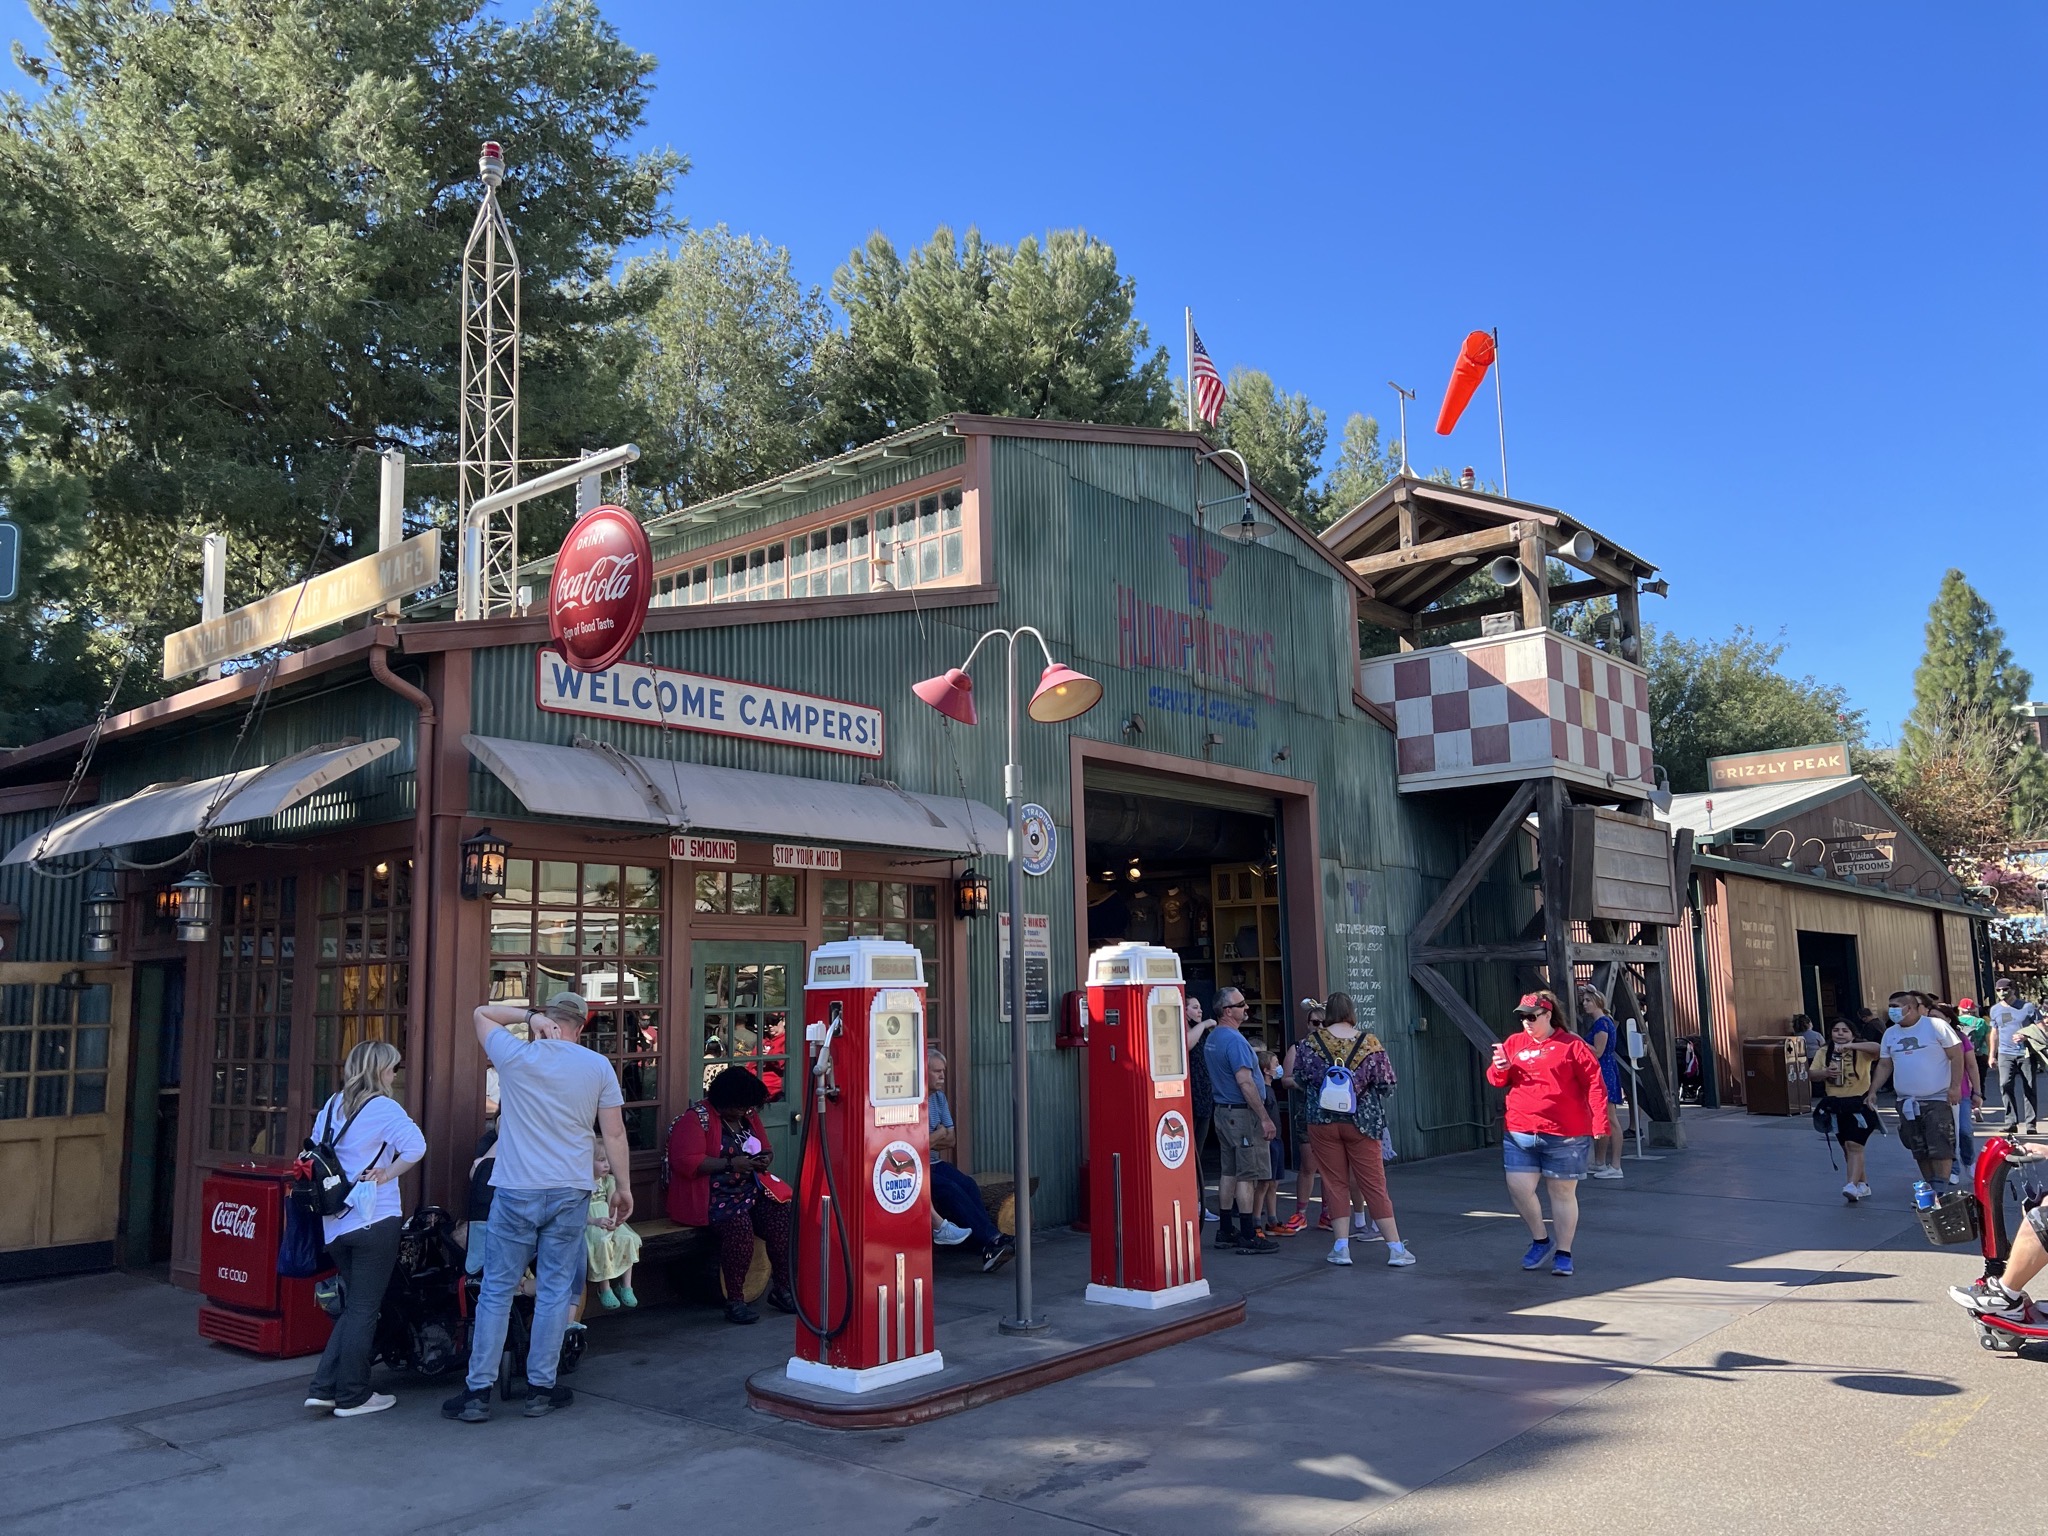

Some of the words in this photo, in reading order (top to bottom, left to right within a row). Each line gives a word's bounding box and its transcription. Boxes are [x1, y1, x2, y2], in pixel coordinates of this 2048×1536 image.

[577, 531, 606, 551] DRINK
[555, 553, 639, 615] Coca-Cola
[195, 625, 226, 658] COLD
[233, 606, 280, 645] DRINKS
[297, 589, 321, 622] AIR
[327, 575, 360, 611] MAIL
[379, 550, 424, 588] MAPS
[563, 627, 574, 641] Sign
[574, 625, 580, 636] of
[580, 618, 596, 635] Good
[595, 617, 614, 631] Taste
[1117, 583, 1276, 705] HUMPHREY'S
[551, 663, 725, 721] WELCOME
[738, 694, 878, 747] CAMPERS!
[1714, 761, 1787, 780] GRIZZLY
[1793, 755, 1841, 771] PEAK
[1027, 808, 1052, 831] TRADING
[670, 838, 685, 856] NO
[690, 839, 735, 860] SMOKING
[775, 846, 793, 864] STOP
[796, 849, 813, 865] YOUR
[816, 851, 839, 868] MOTOR
[1837, 861, 1890, 873] RESTROOMS
[1028, 917, 1047, 928] HIKES
[817, 964, 851, 975] REGULAR
[1098, 965, 1129, 974] PREMIUM
[1169, 1150, 1178, 1159] GAS
[885, 1178, 912, 1191] CONDOR
[892, 1189, 906, 1201] GAS
[211, 1201, 258, 1240] Coca-Cola
[218, 1266, 229, 1280] ICE
[229, 1269, 248, 1284] COLD
